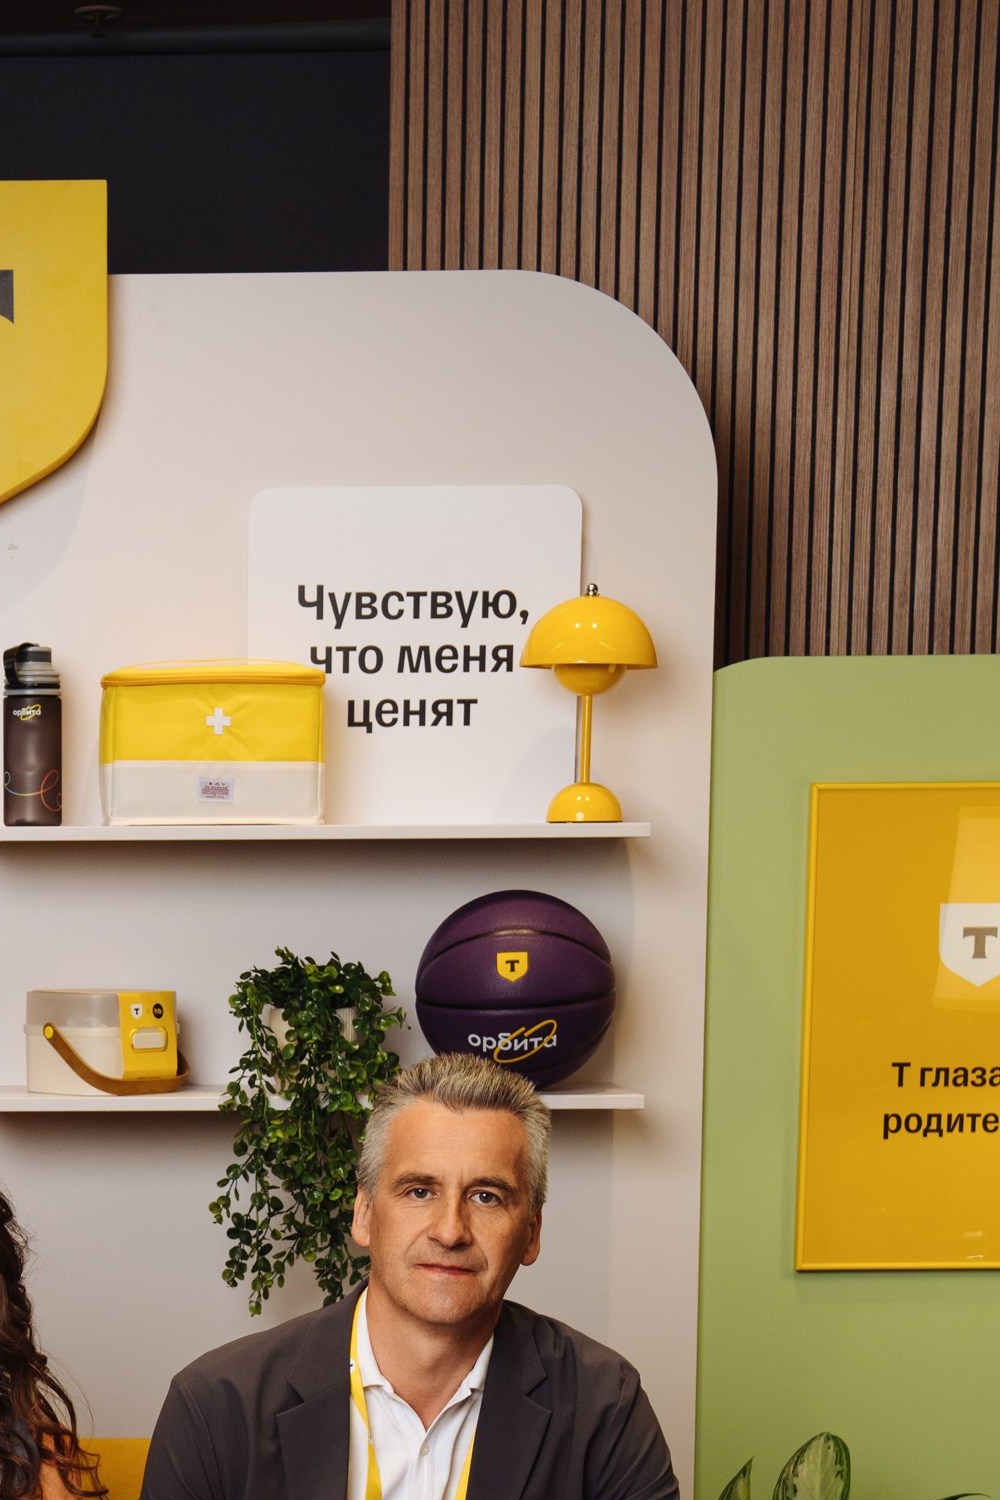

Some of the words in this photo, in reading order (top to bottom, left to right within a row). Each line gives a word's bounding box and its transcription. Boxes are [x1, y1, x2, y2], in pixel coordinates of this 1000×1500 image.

[297, 584, 529, 630] Чувствую,
[310, 645, 384, 674] что
[397, 644, 514, 674] меня
[347, 698, 478, 734] ценят
[962, 926, 999, 959] Т
[467, 1027, 557, 1053] орбита
[891, 1062, 911, 1088] Т
[882, 1112, 1000, 1140] родите
